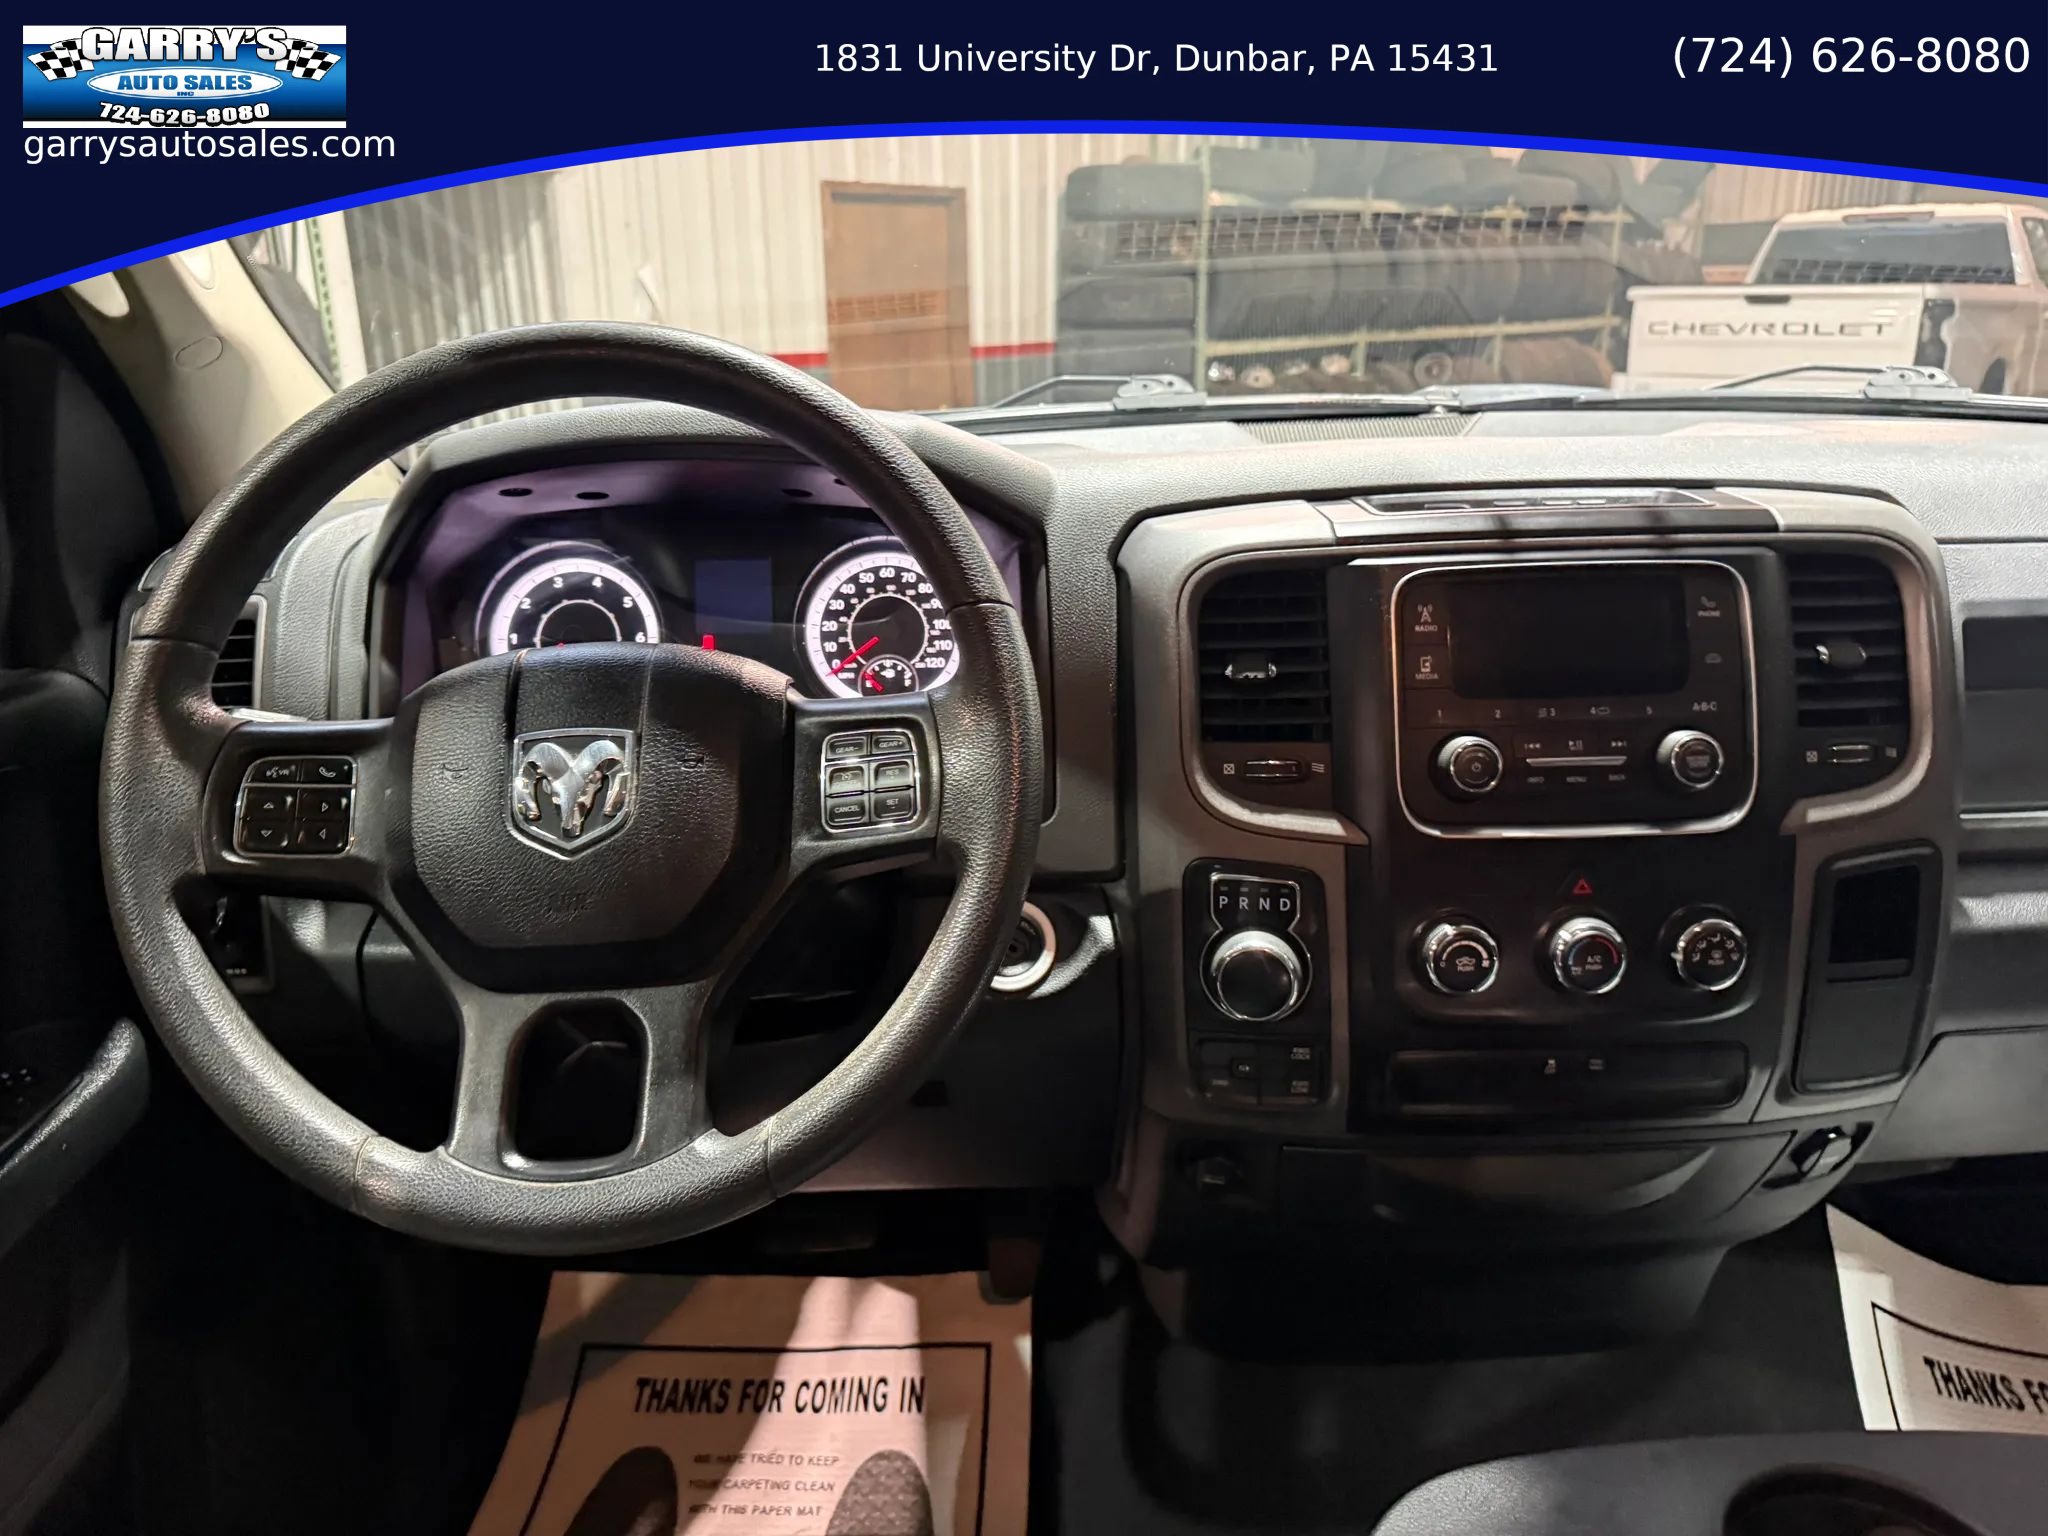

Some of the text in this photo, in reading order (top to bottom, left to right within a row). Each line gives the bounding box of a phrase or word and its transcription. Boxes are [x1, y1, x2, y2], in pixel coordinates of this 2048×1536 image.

[1648, 321, 1893, 337] CHEVROLET
[859, 572, 875, 583] 50
[879, 567, 895, 578] 60
[901, 572, 916, 583] 70
[553, 576, 563, 588] 3
[592, 576, 603, 587] 4
[839, 584, 855, 594] 40
[918, 583, 933, 594] 80
[520, 597, 531, 609] 2
[622, 596, 633, 608] 5
[829, 600, 845, 610] 30
[822, 621, 838, 631] 20
[1415, 624, 1438, 632] RADIO
[509, 633, 518, 645] 1
[635, 632, 646, 643] 6
[824, 642, 837, 652] 10
[934, 640, 952, 651] 110
[925, 658, 945, 668] 120
[834, 805, 860, 813] CANCEL
[1219, 896, 1291, 911] P R N D
[1922, 1355, 2026, 1412] THANKS
[634, 1376, 926, 1414] THANKS FOR COMING IN
[751, 1453, 784, 1465] TRIED
[789, 1454, 804, 1465] TO
[807, 1455, 840, 1466] KEEP
[723, 1479, 792, 1491] CARPETING
[795, 1480, 836, 1492] CLEAN
[722, 1504, 747, 1515] THIS
[751, 1505, 793, 1516] PAPER
[797, 1506, 822, 1516] MAT
